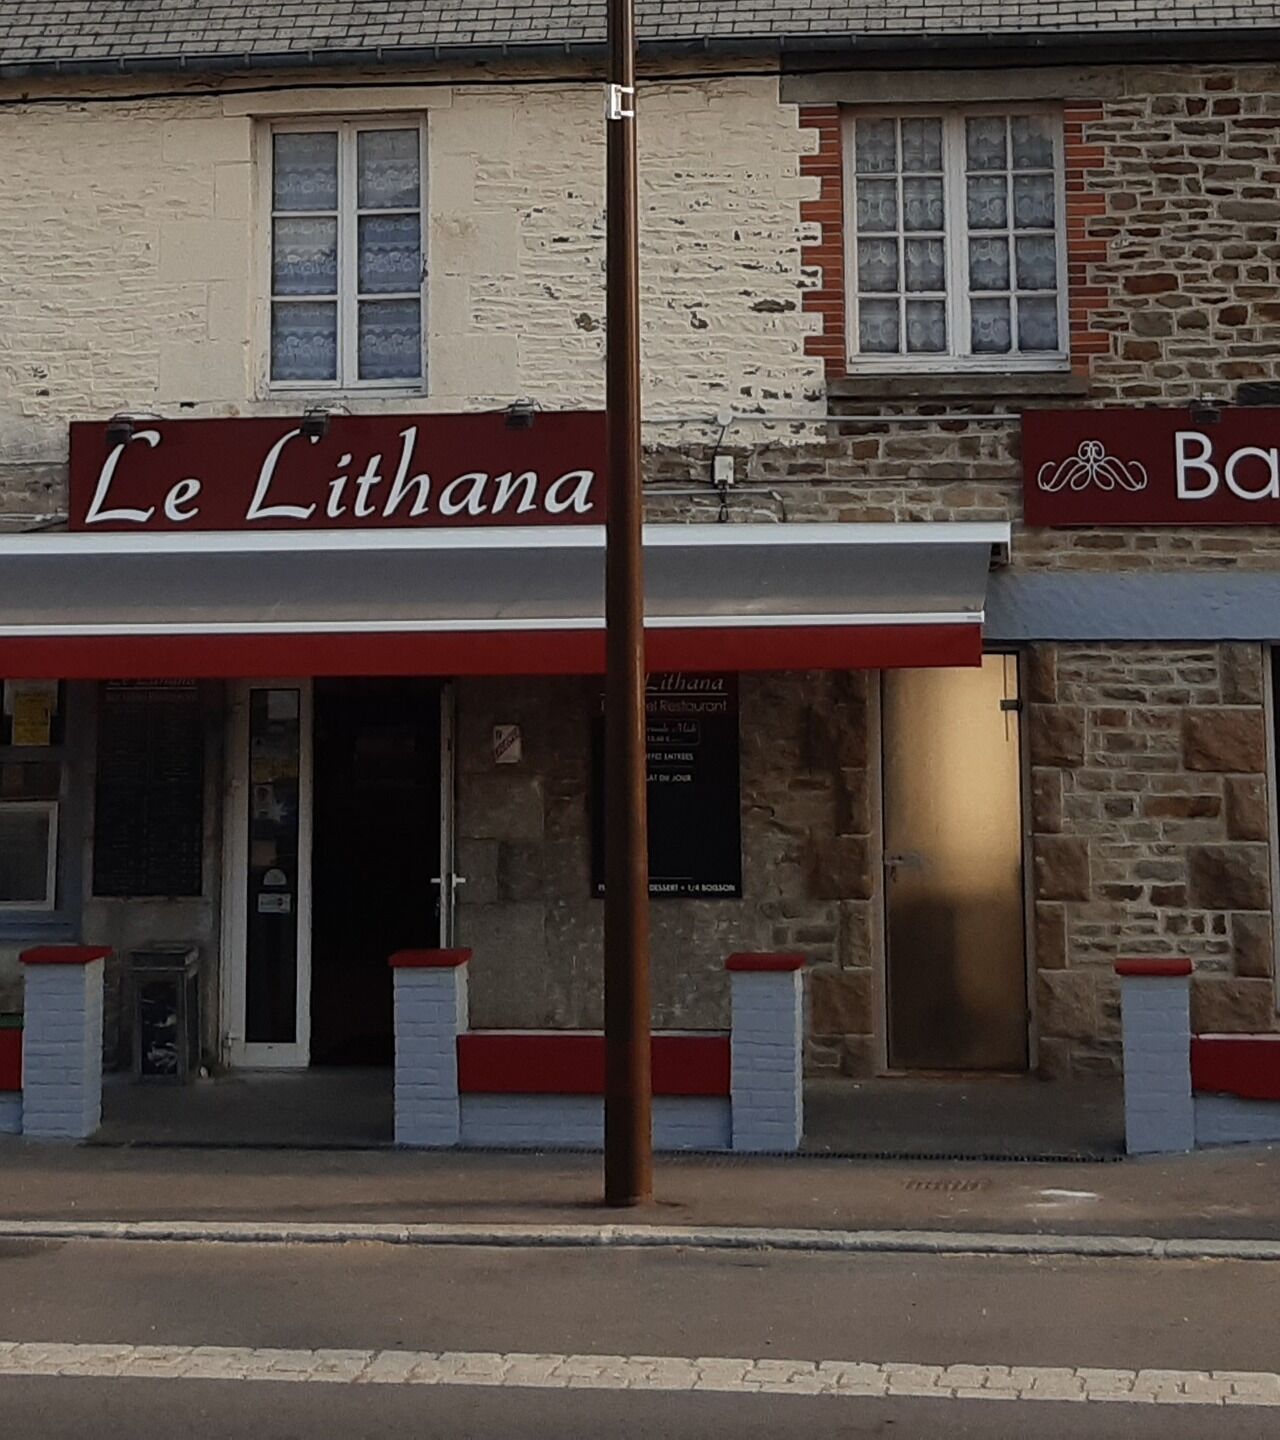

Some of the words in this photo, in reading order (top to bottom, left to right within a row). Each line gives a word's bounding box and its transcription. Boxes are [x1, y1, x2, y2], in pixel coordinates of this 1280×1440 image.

[85, 430, 201, 523] Le
[246, 425, 595, 520] Lithana
[660, 699, 728, 713] Restaurant
